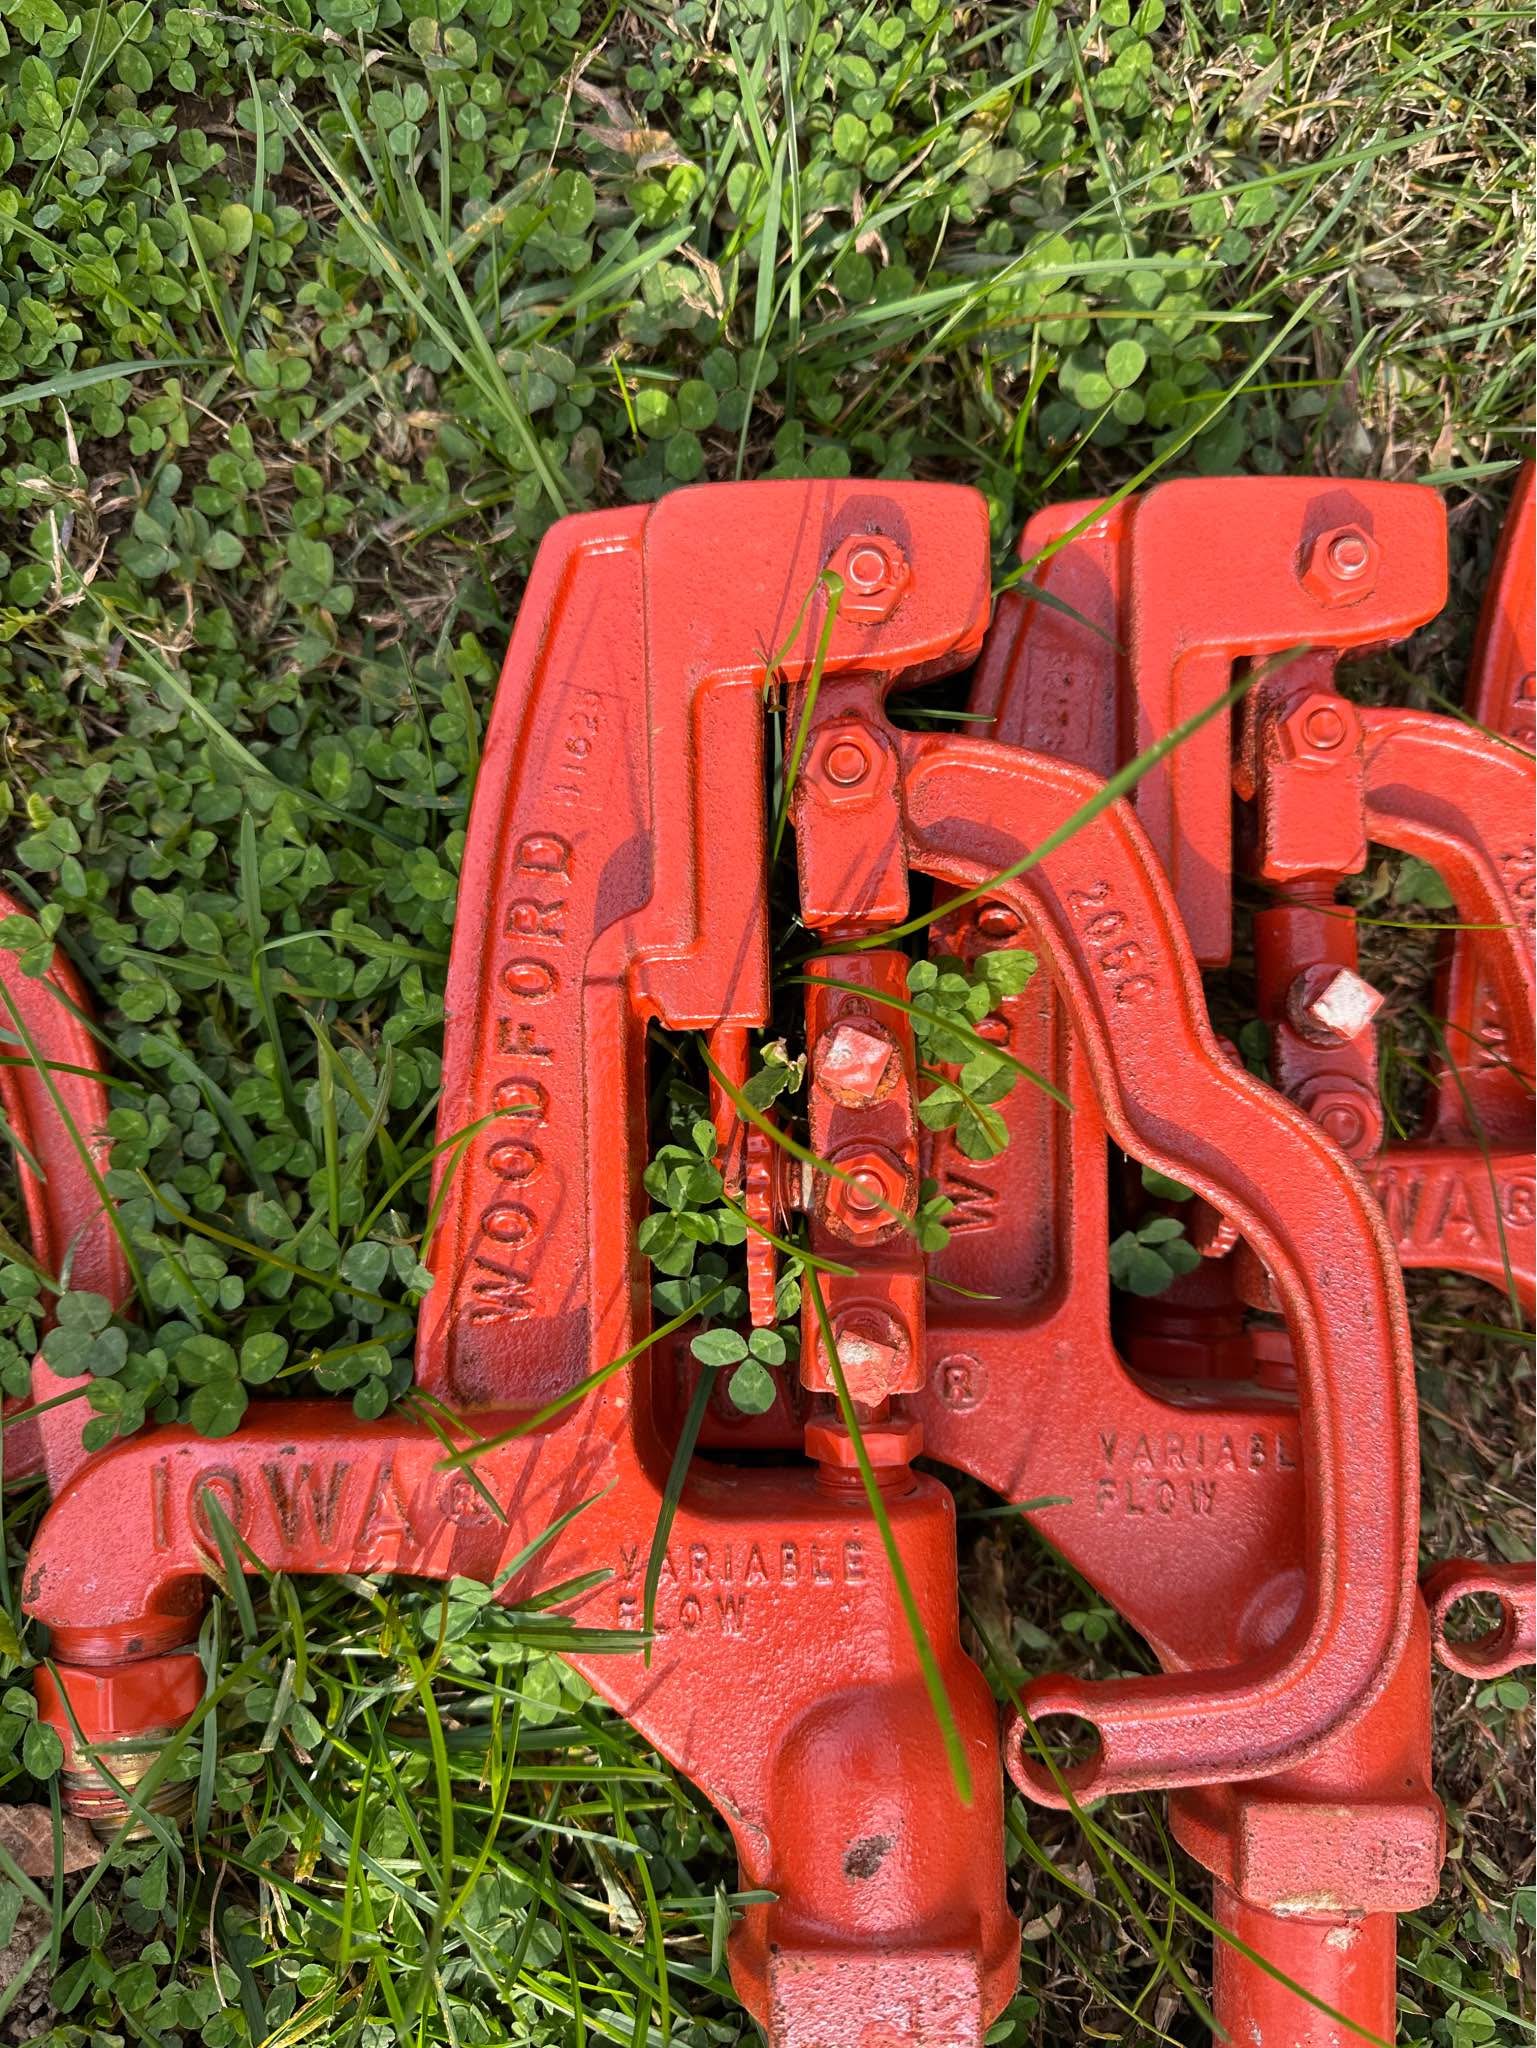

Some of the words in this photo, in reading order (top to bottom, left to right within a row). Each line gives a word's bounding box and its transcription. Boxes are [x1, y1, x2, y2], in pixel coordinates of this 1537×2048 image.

[471, 830, 576, 1325] WOODFORD
[1098, 1427, 1298, 1474] VARIABL
[1096, 1477, 1217, 1518] FLOW
[617, 1593, 750, 1640] FOW
